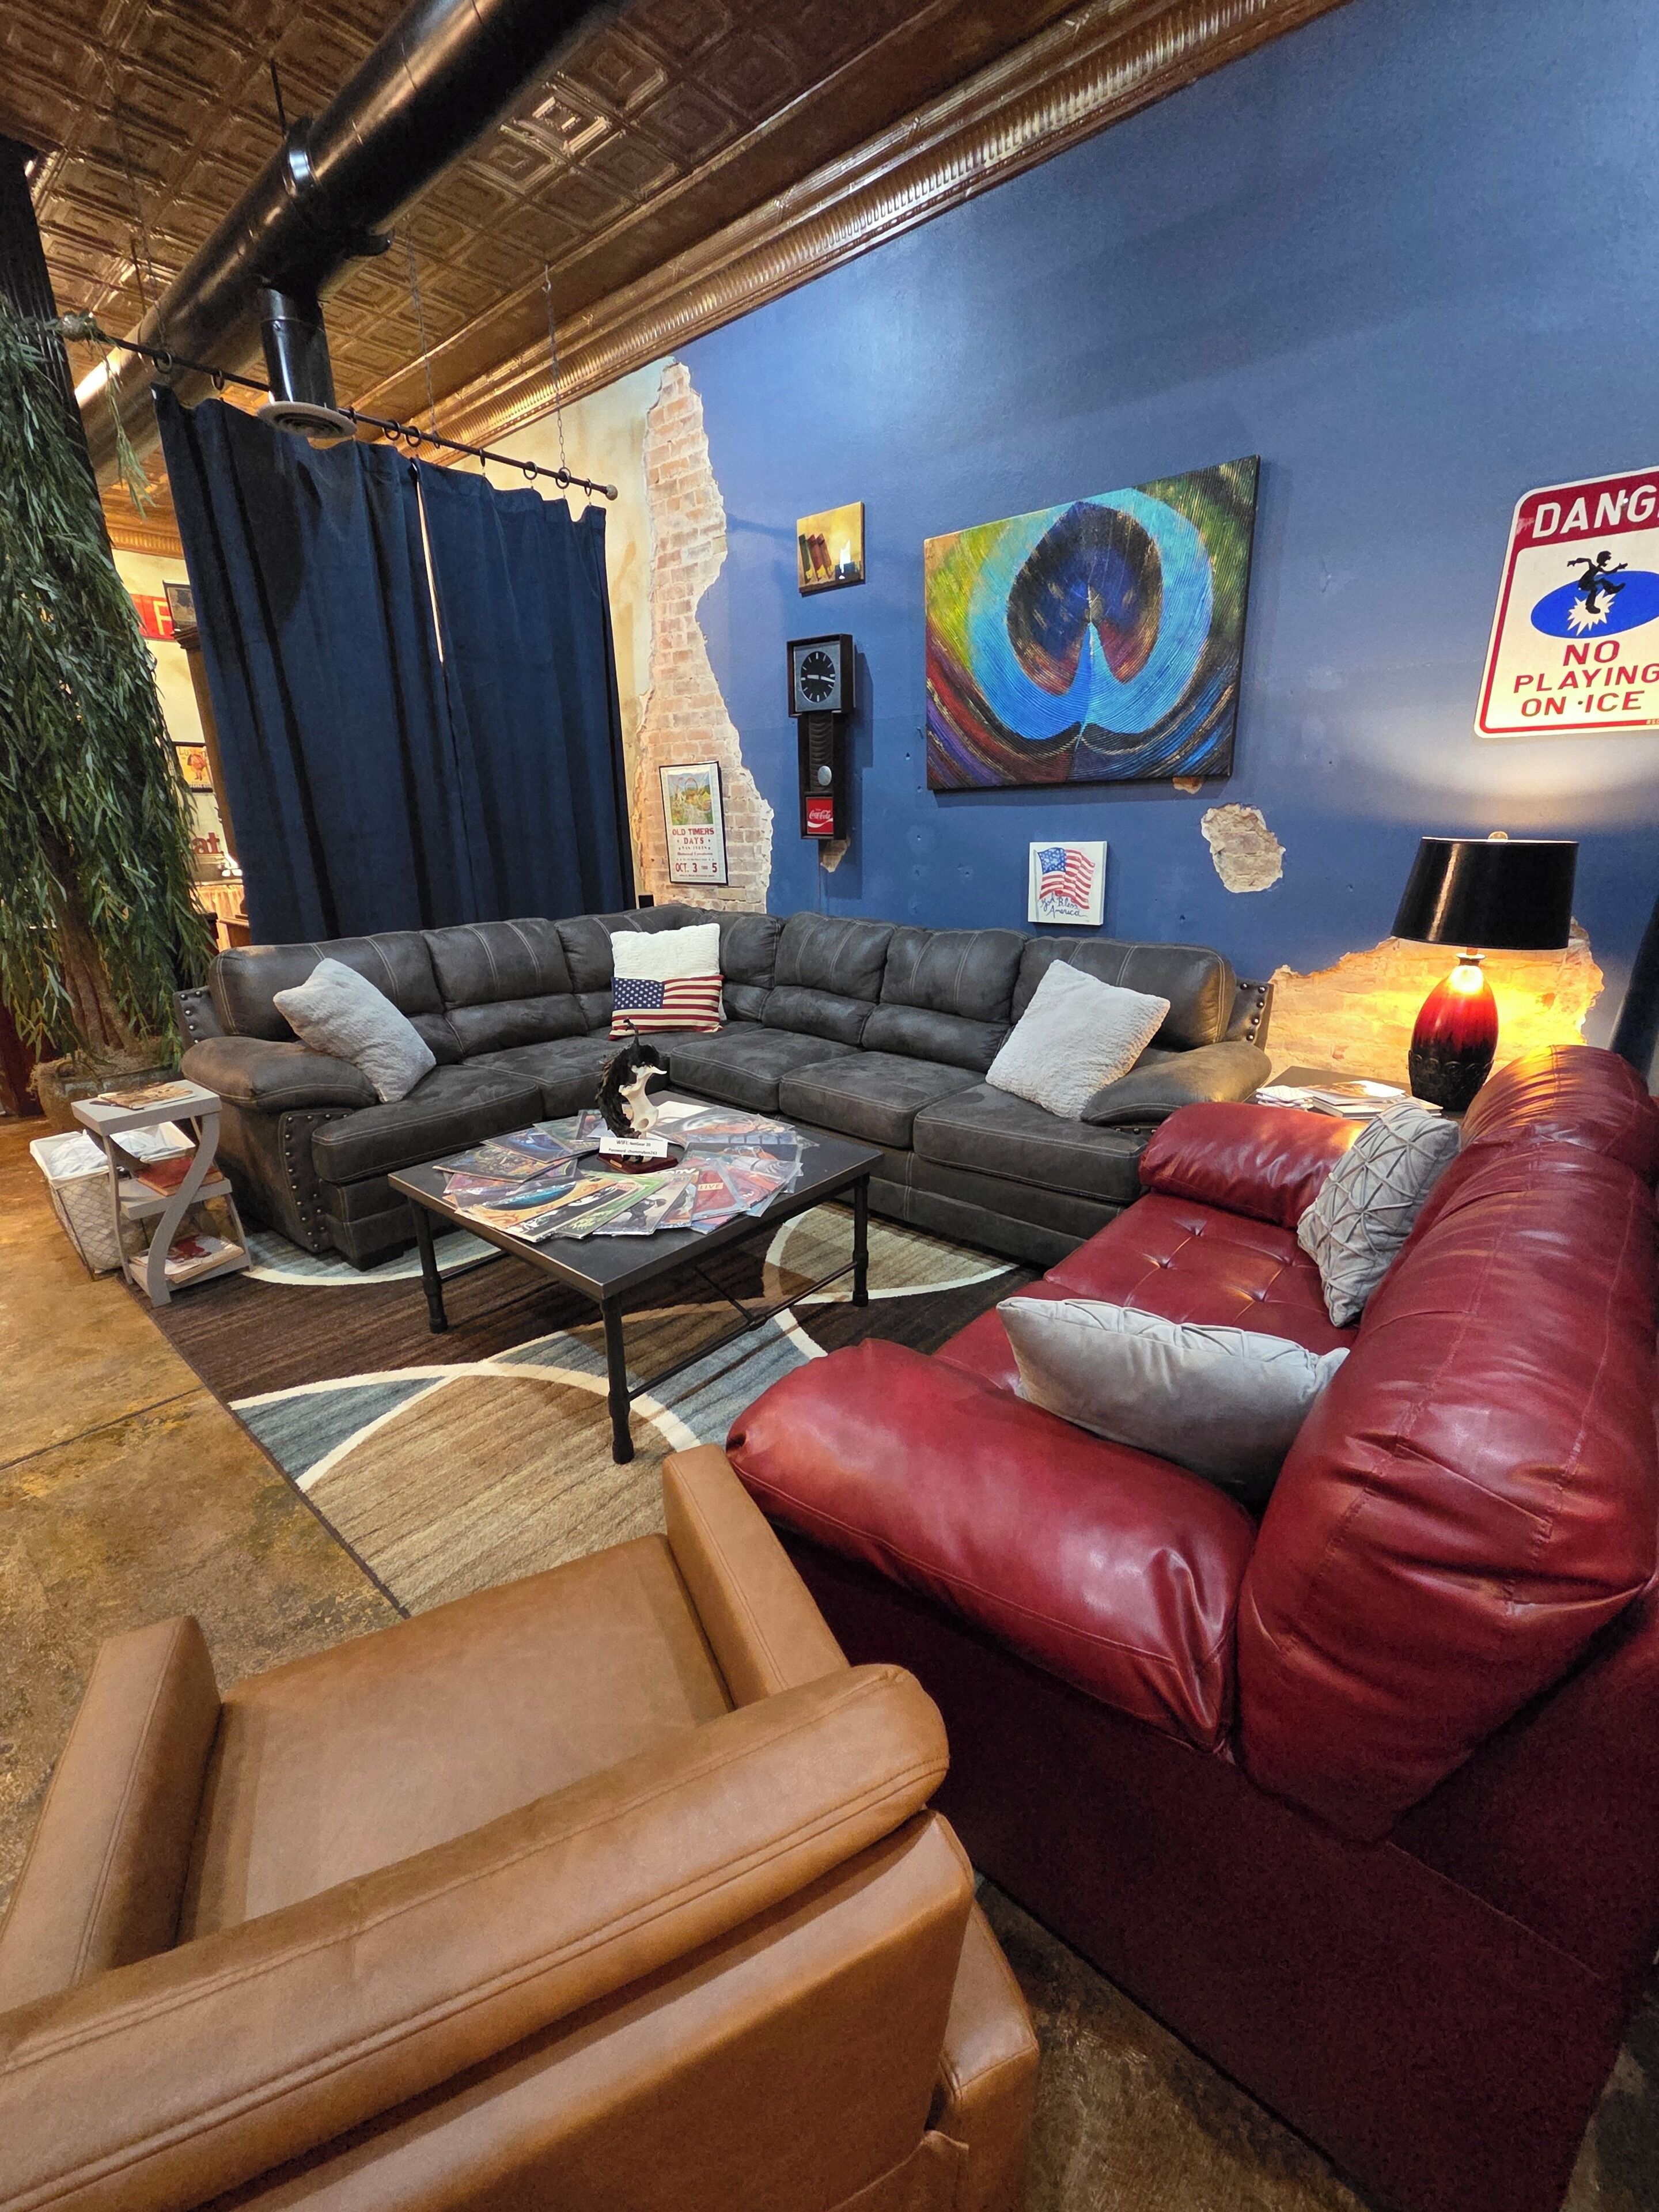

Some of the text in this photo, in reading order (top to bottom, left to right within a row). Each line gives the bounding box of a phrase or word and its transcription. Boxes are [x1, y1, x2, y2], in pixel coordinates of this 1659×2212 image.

[1532, 484, 1659, 539] DANG
[1563, 640, 1620, 666] NO
[1513, 663, 1659, 694] PLAYING
[1521, 691, 1645, 717] ON ICE
[675, 862, 690, 873] OCT.
[692, 863, 698, 873] 3
[712, 862, 718, 873] 5
[1046, 905, 1088, 919] America
[1057, 896, 1078, 910] Bless
